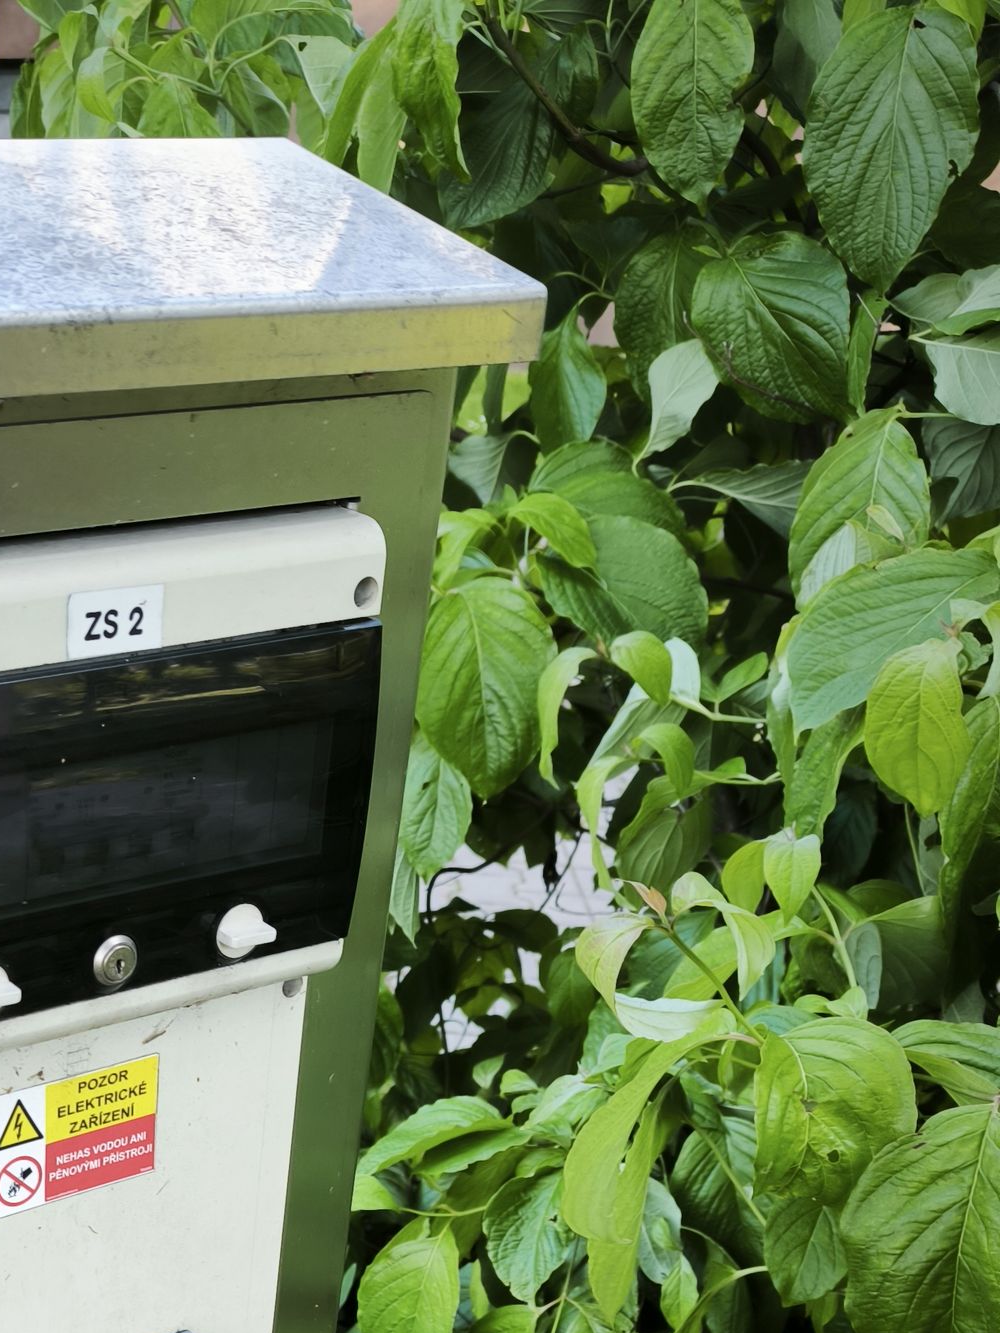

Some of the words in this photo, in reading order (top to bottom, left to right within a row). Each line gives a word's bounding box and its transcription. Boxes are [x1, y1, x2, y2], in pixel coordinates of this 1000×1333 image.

[84, 609, 118, 641] ZS
[128, 606, 144, 636] 2
[77, 1069, 129, 1094] POZOR
[57, 1081, 147, 1119] ELEKTRICKÉ
[68, 1103, 135, 1134] ZAŘÍZENÍ
[48, 1158, 101, 1182] PĚNOVÝMI
[101, 1144, 153, 1168] PŘÍSTROJI
[55, 1148, 91, 1166] NEHAS
[92, 1137, 128, 1155] VODOU
[129, 1131, 147, 1145] ANI
